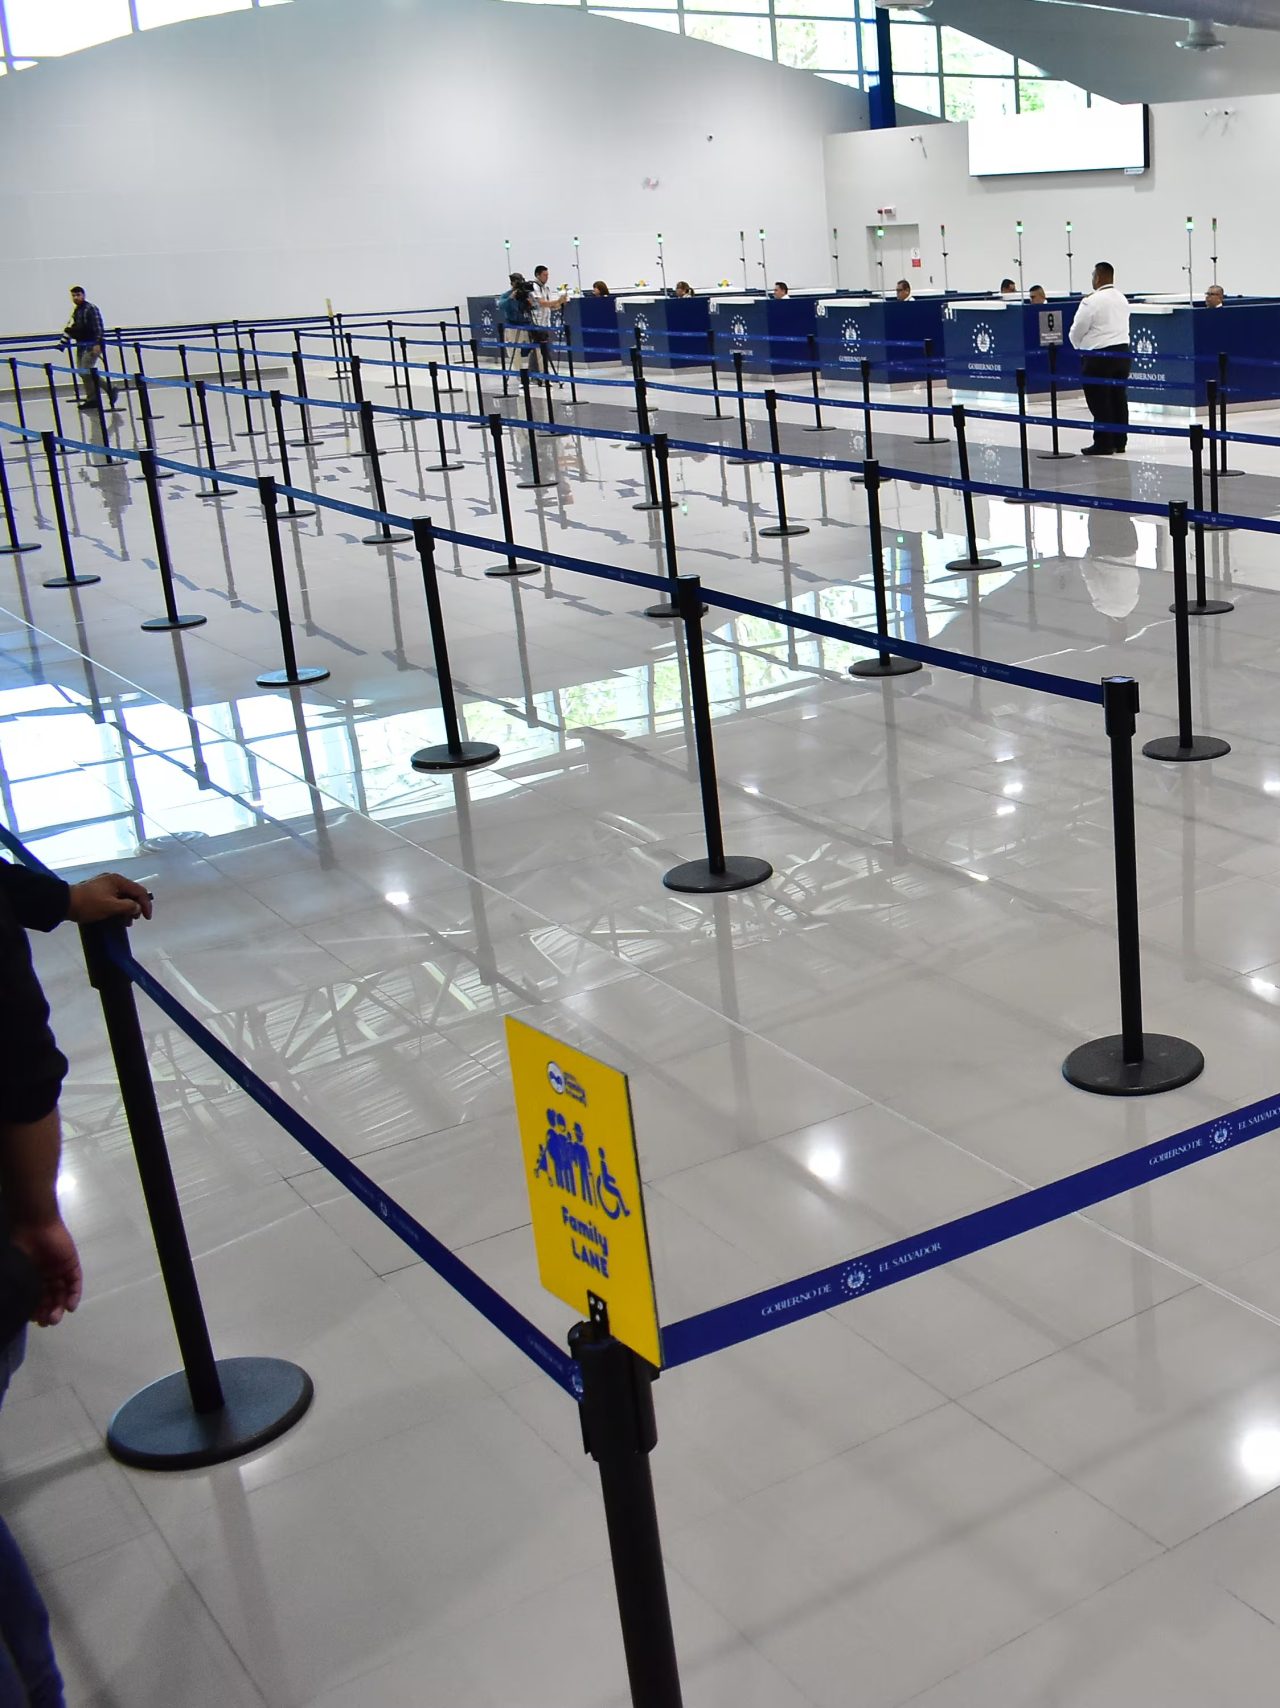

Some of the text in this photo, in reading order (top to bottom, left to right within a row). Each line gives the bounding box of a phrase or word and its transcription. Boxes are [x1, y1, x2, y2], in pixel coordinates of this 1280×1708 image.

[944, 307, 953, 320] 11
[1149, 1144, 1191, 1165] GOBIERNO
[1191, 1137, 1203, 1148] DE
[1238, 1120, 1247, 1130] EL
[562, 1206, 608, 1257] Family
[571, 1236, 609, 1279] LANE
[761, 1242, 942, 1316] GOBIERNO DE EL SALVADOR
